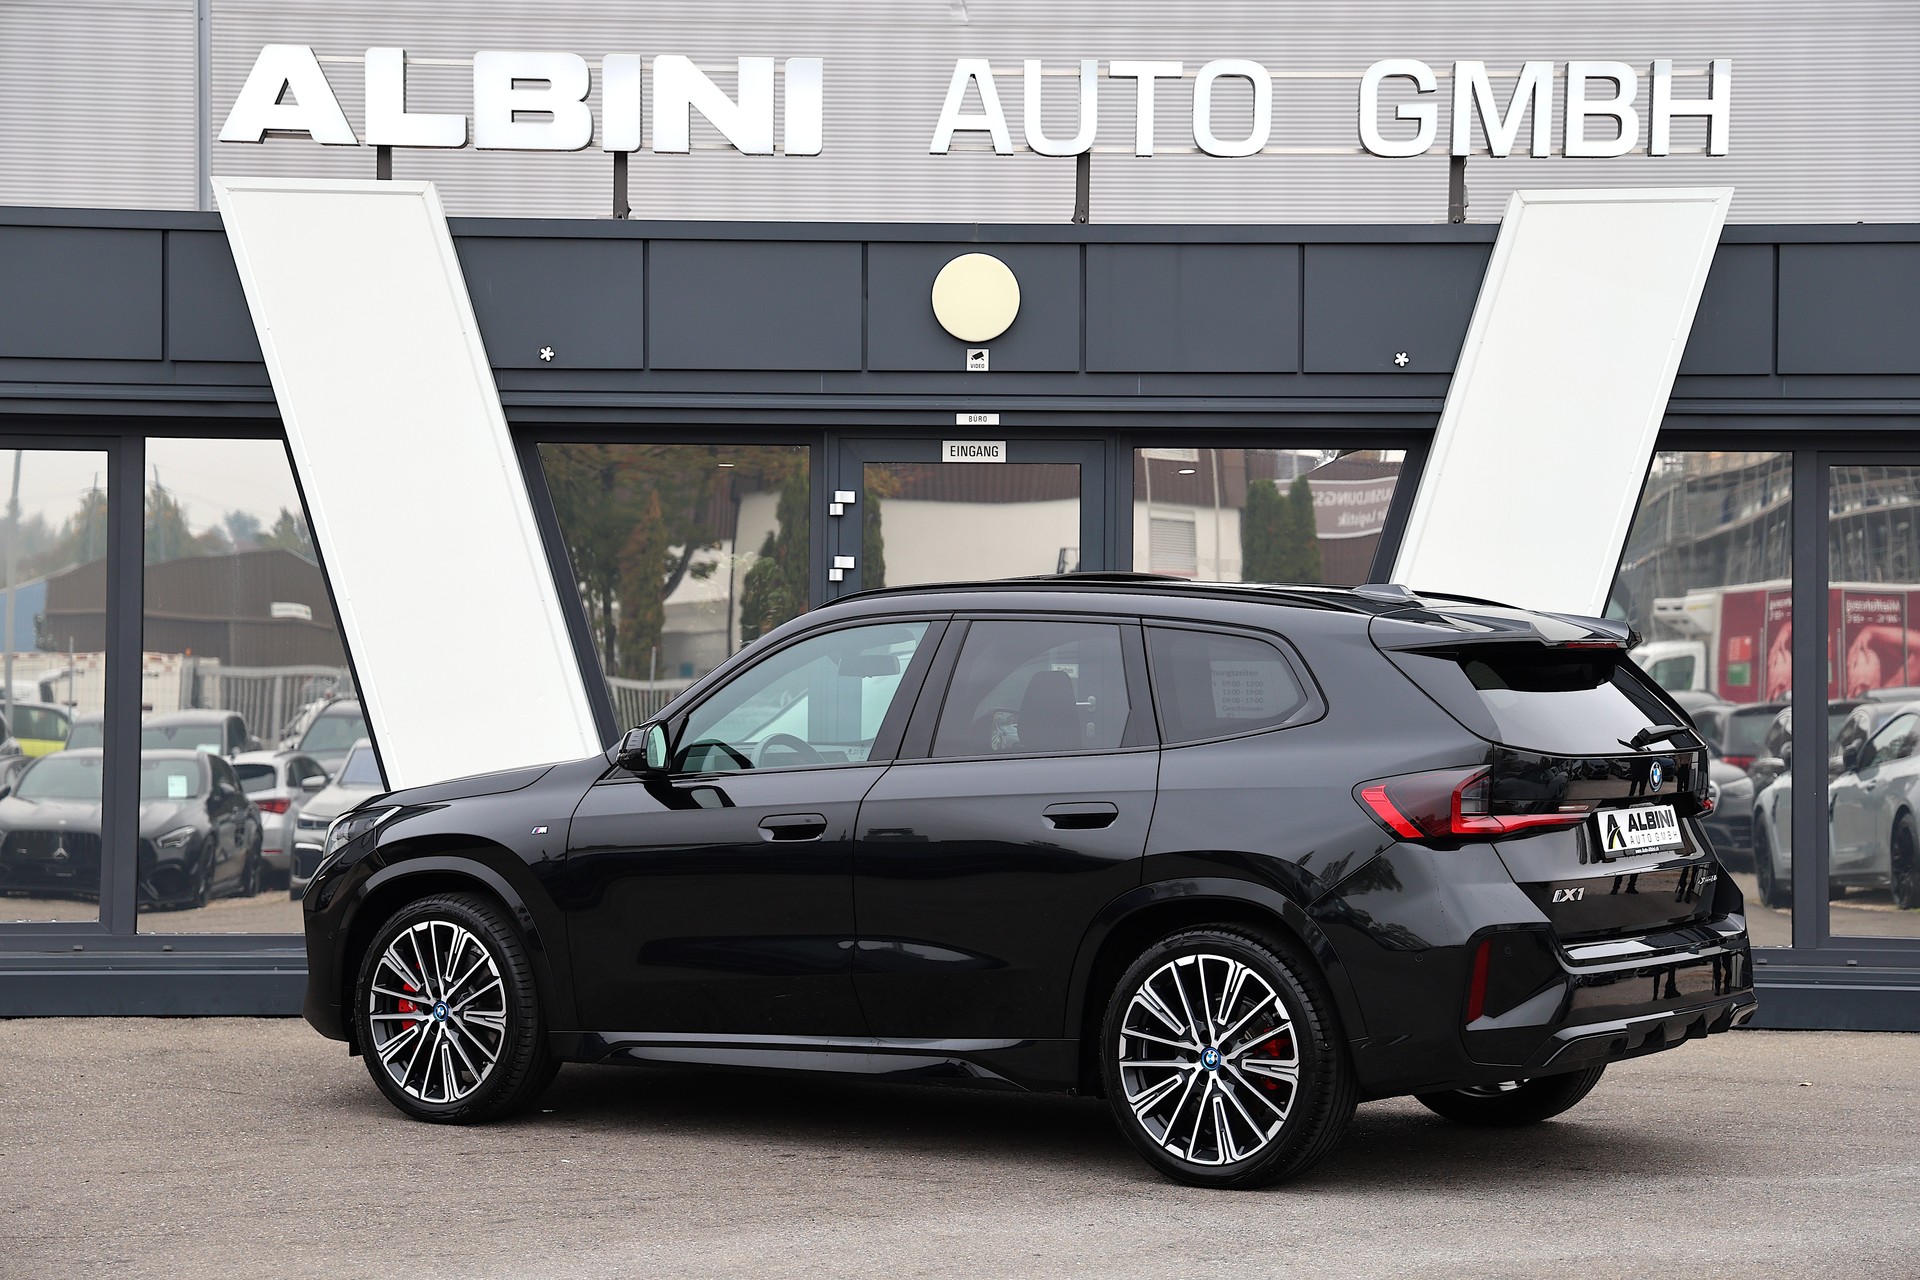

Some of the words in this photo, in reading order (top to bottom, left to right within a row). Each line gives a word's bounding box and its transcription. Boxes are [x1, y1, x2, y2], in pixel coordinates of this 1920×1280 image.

[218, 44, 824, 156] ALBINI
[929, 58, 1272, 158] AUTO
[1359, 58, 1733, 158] GMBH
[950, 445, 999, 457] EINGANG
[1628, 809, 1675, 832] ALBINI
[1630, 833, 1653, 845] AUTO
[1655, 830, 1678, 842] GMBH
[1552, 887, 1585, 903] iX1
